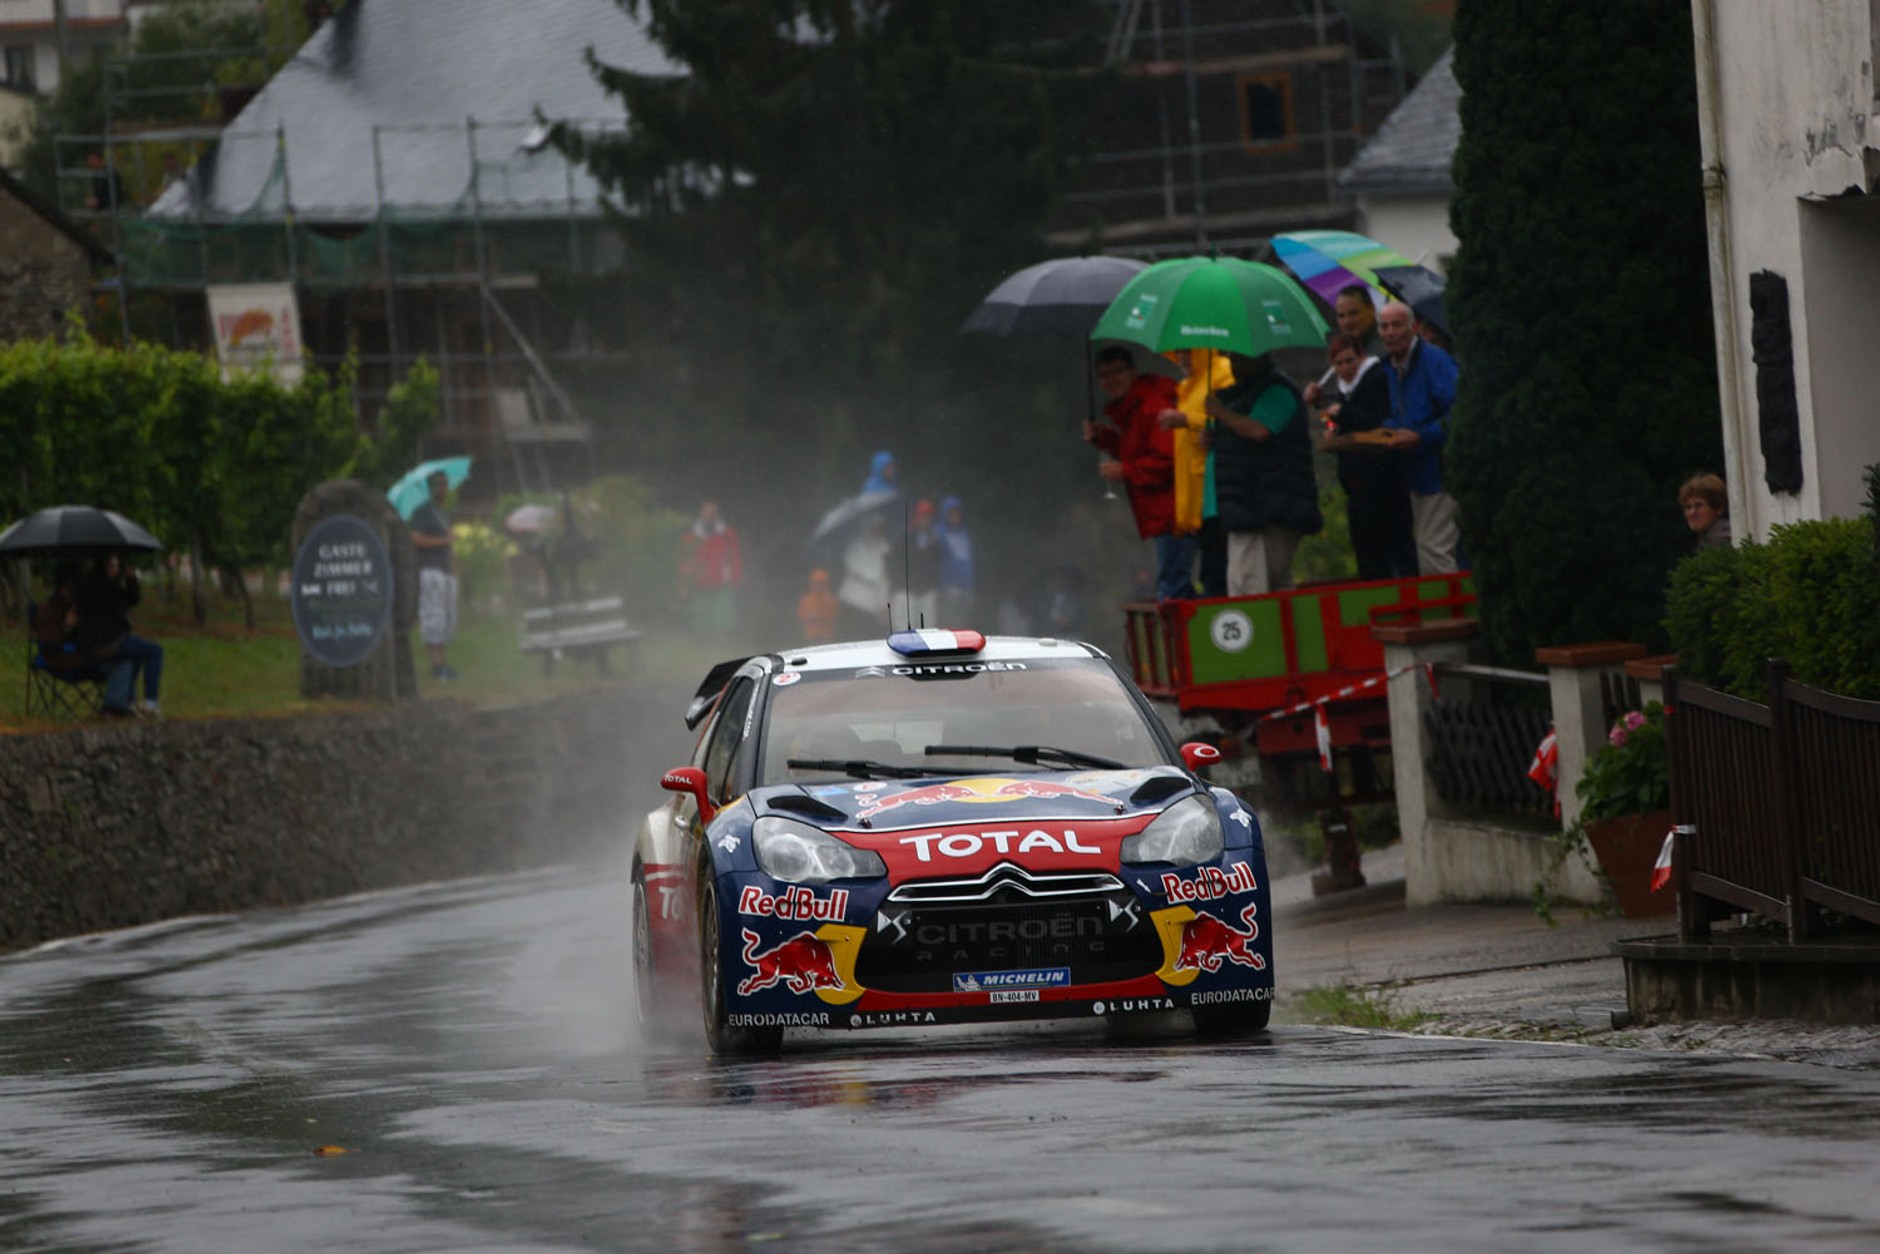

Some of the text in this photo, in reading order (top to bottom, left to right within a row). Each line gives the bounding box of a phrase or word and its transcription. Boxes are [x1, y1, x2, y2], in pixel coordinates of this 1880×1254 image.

[1222, 621, 1241, 641] 25
[664, 774, 692, 785] TOTAL
[899, 829, 1101, 862] TOTAL
[984, 971, 1064, 985] MICHELIN
[992, 990, 1037, 1003] BN-404-MV
[1110, 998, 1174, 1011] LUHTA
[729, 1013, 829, 1026] EURODATACAR
[866, 1011, 936, 1025] LUHTA
